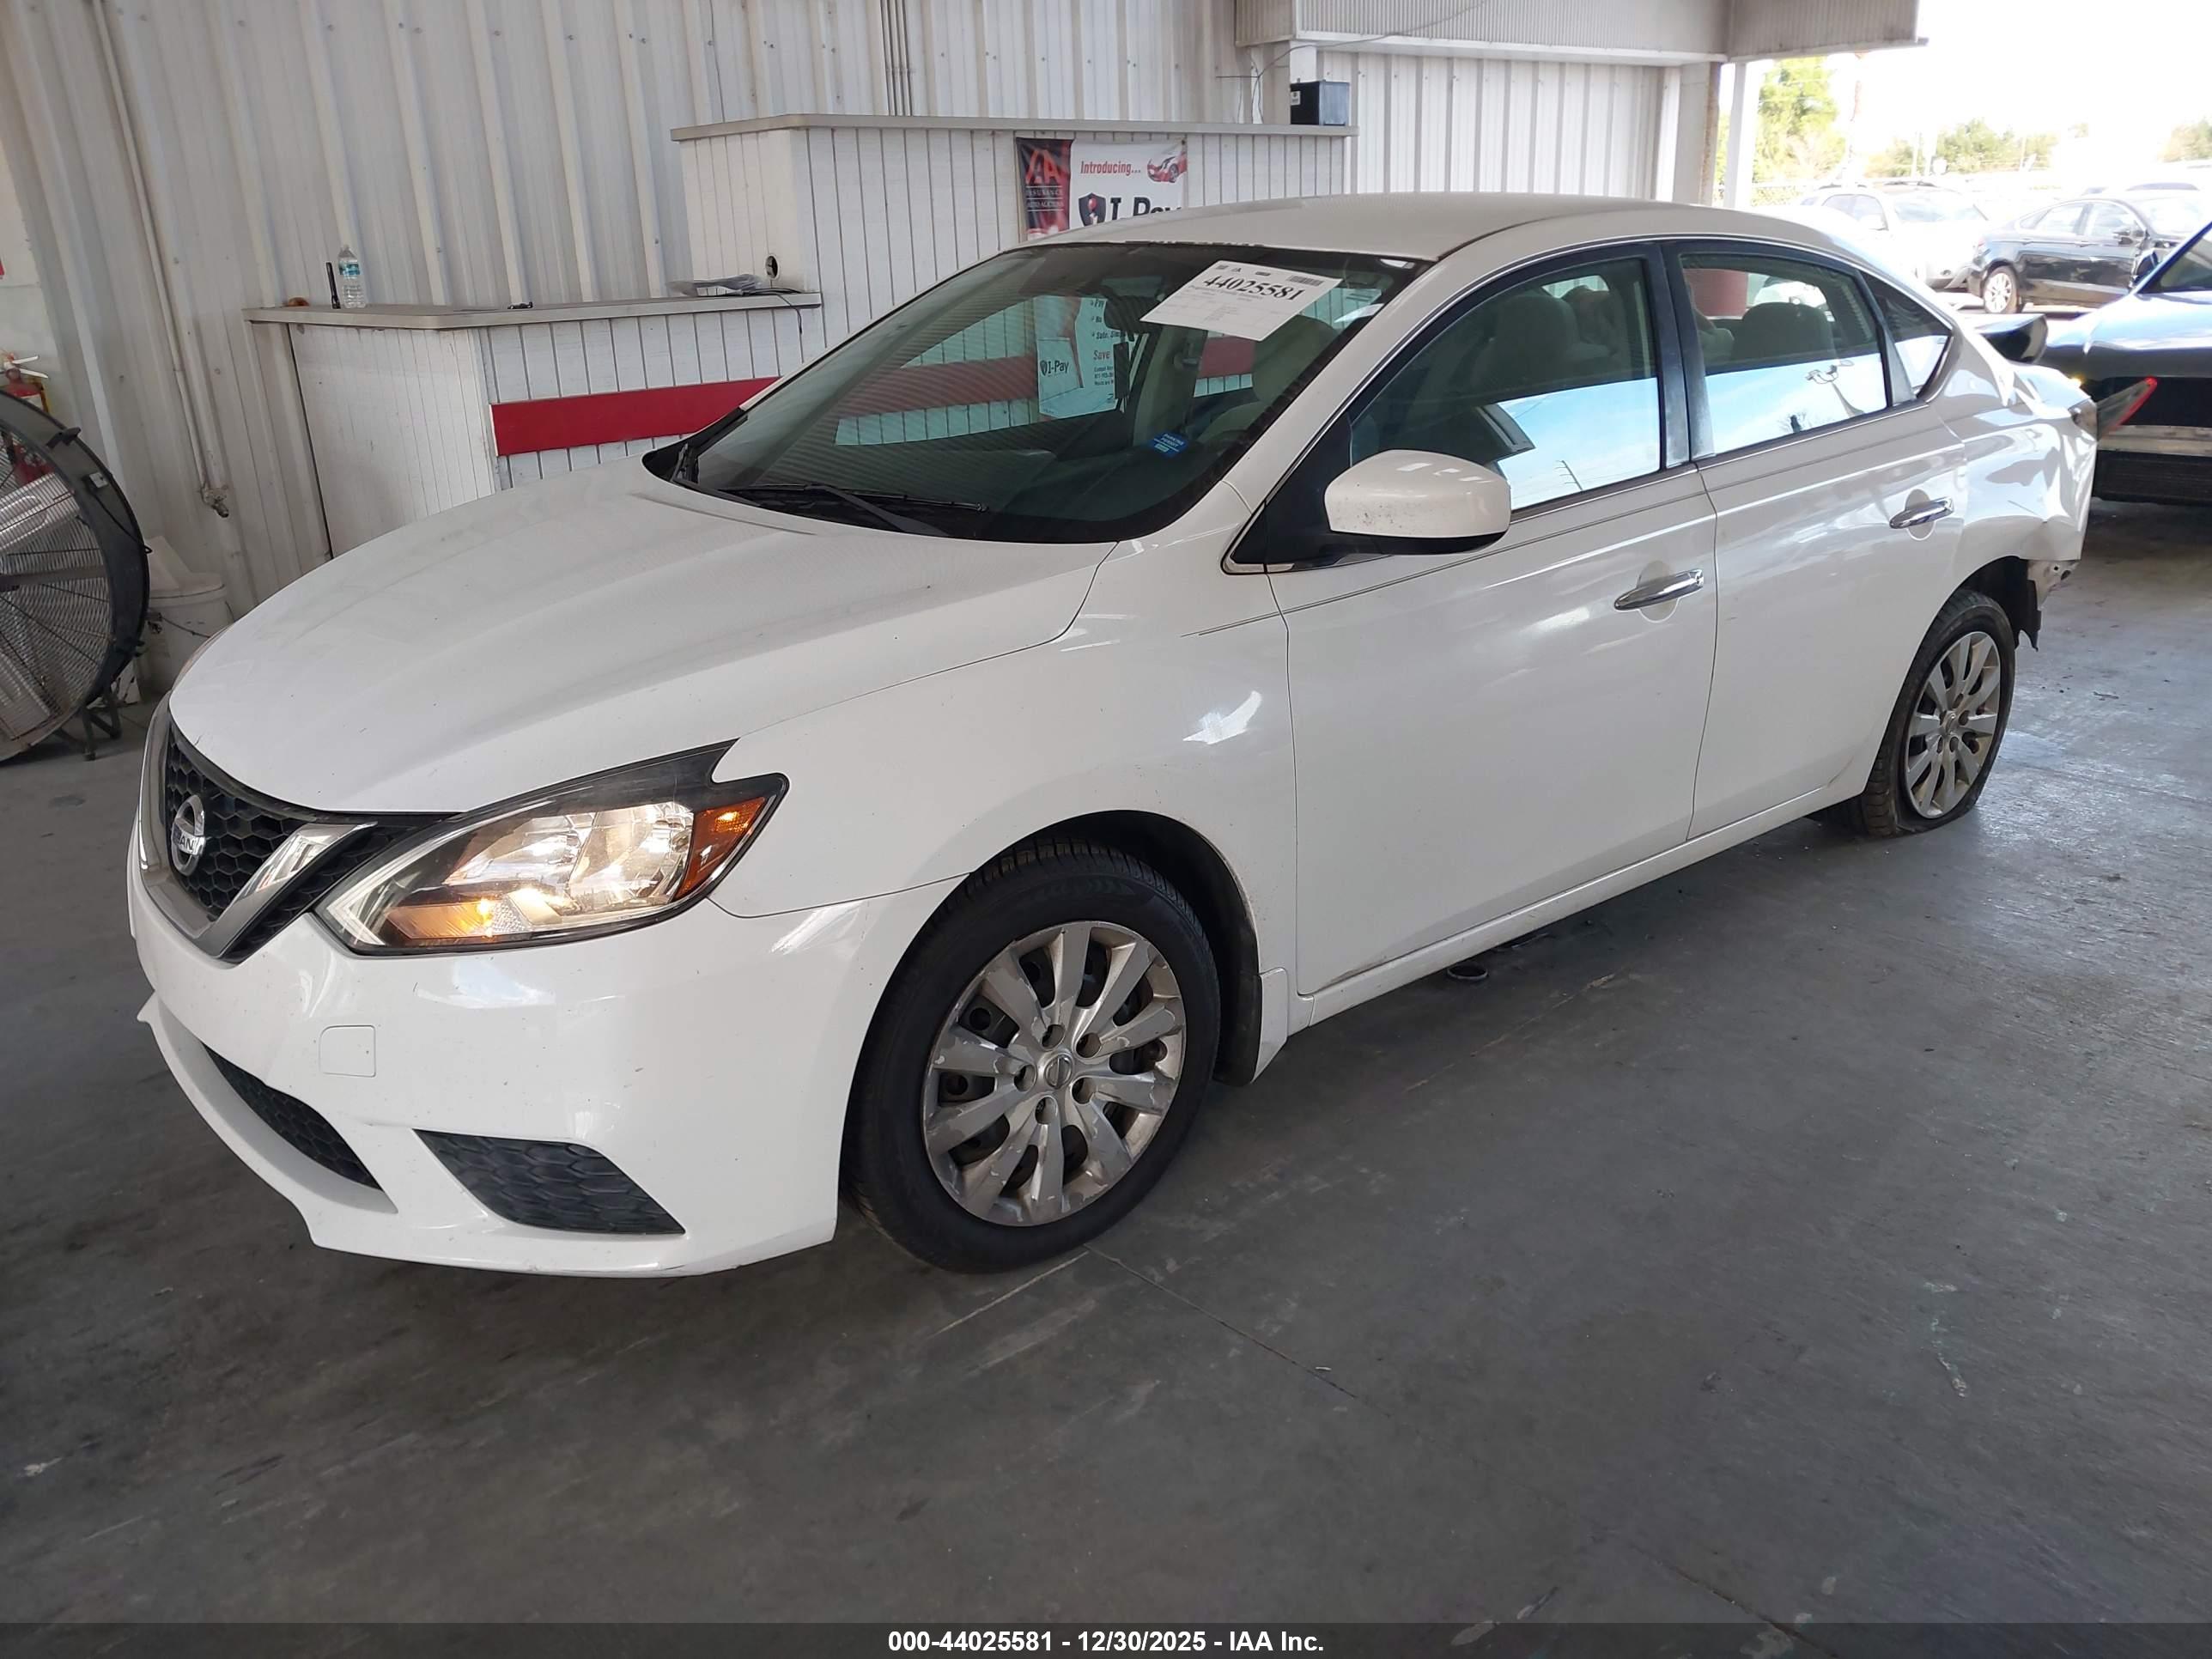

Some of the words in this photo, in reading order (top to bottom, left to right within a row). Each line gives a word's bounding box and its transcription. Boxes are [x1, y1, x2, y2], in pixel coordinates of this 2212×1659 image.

[1079, 161, 1141, 177] Introducing...
[1204, 276, 1305, 301] 44025581
[1093, 349, 1110, 361] Save
[1048, 360, 1069, 374] I-Pay
